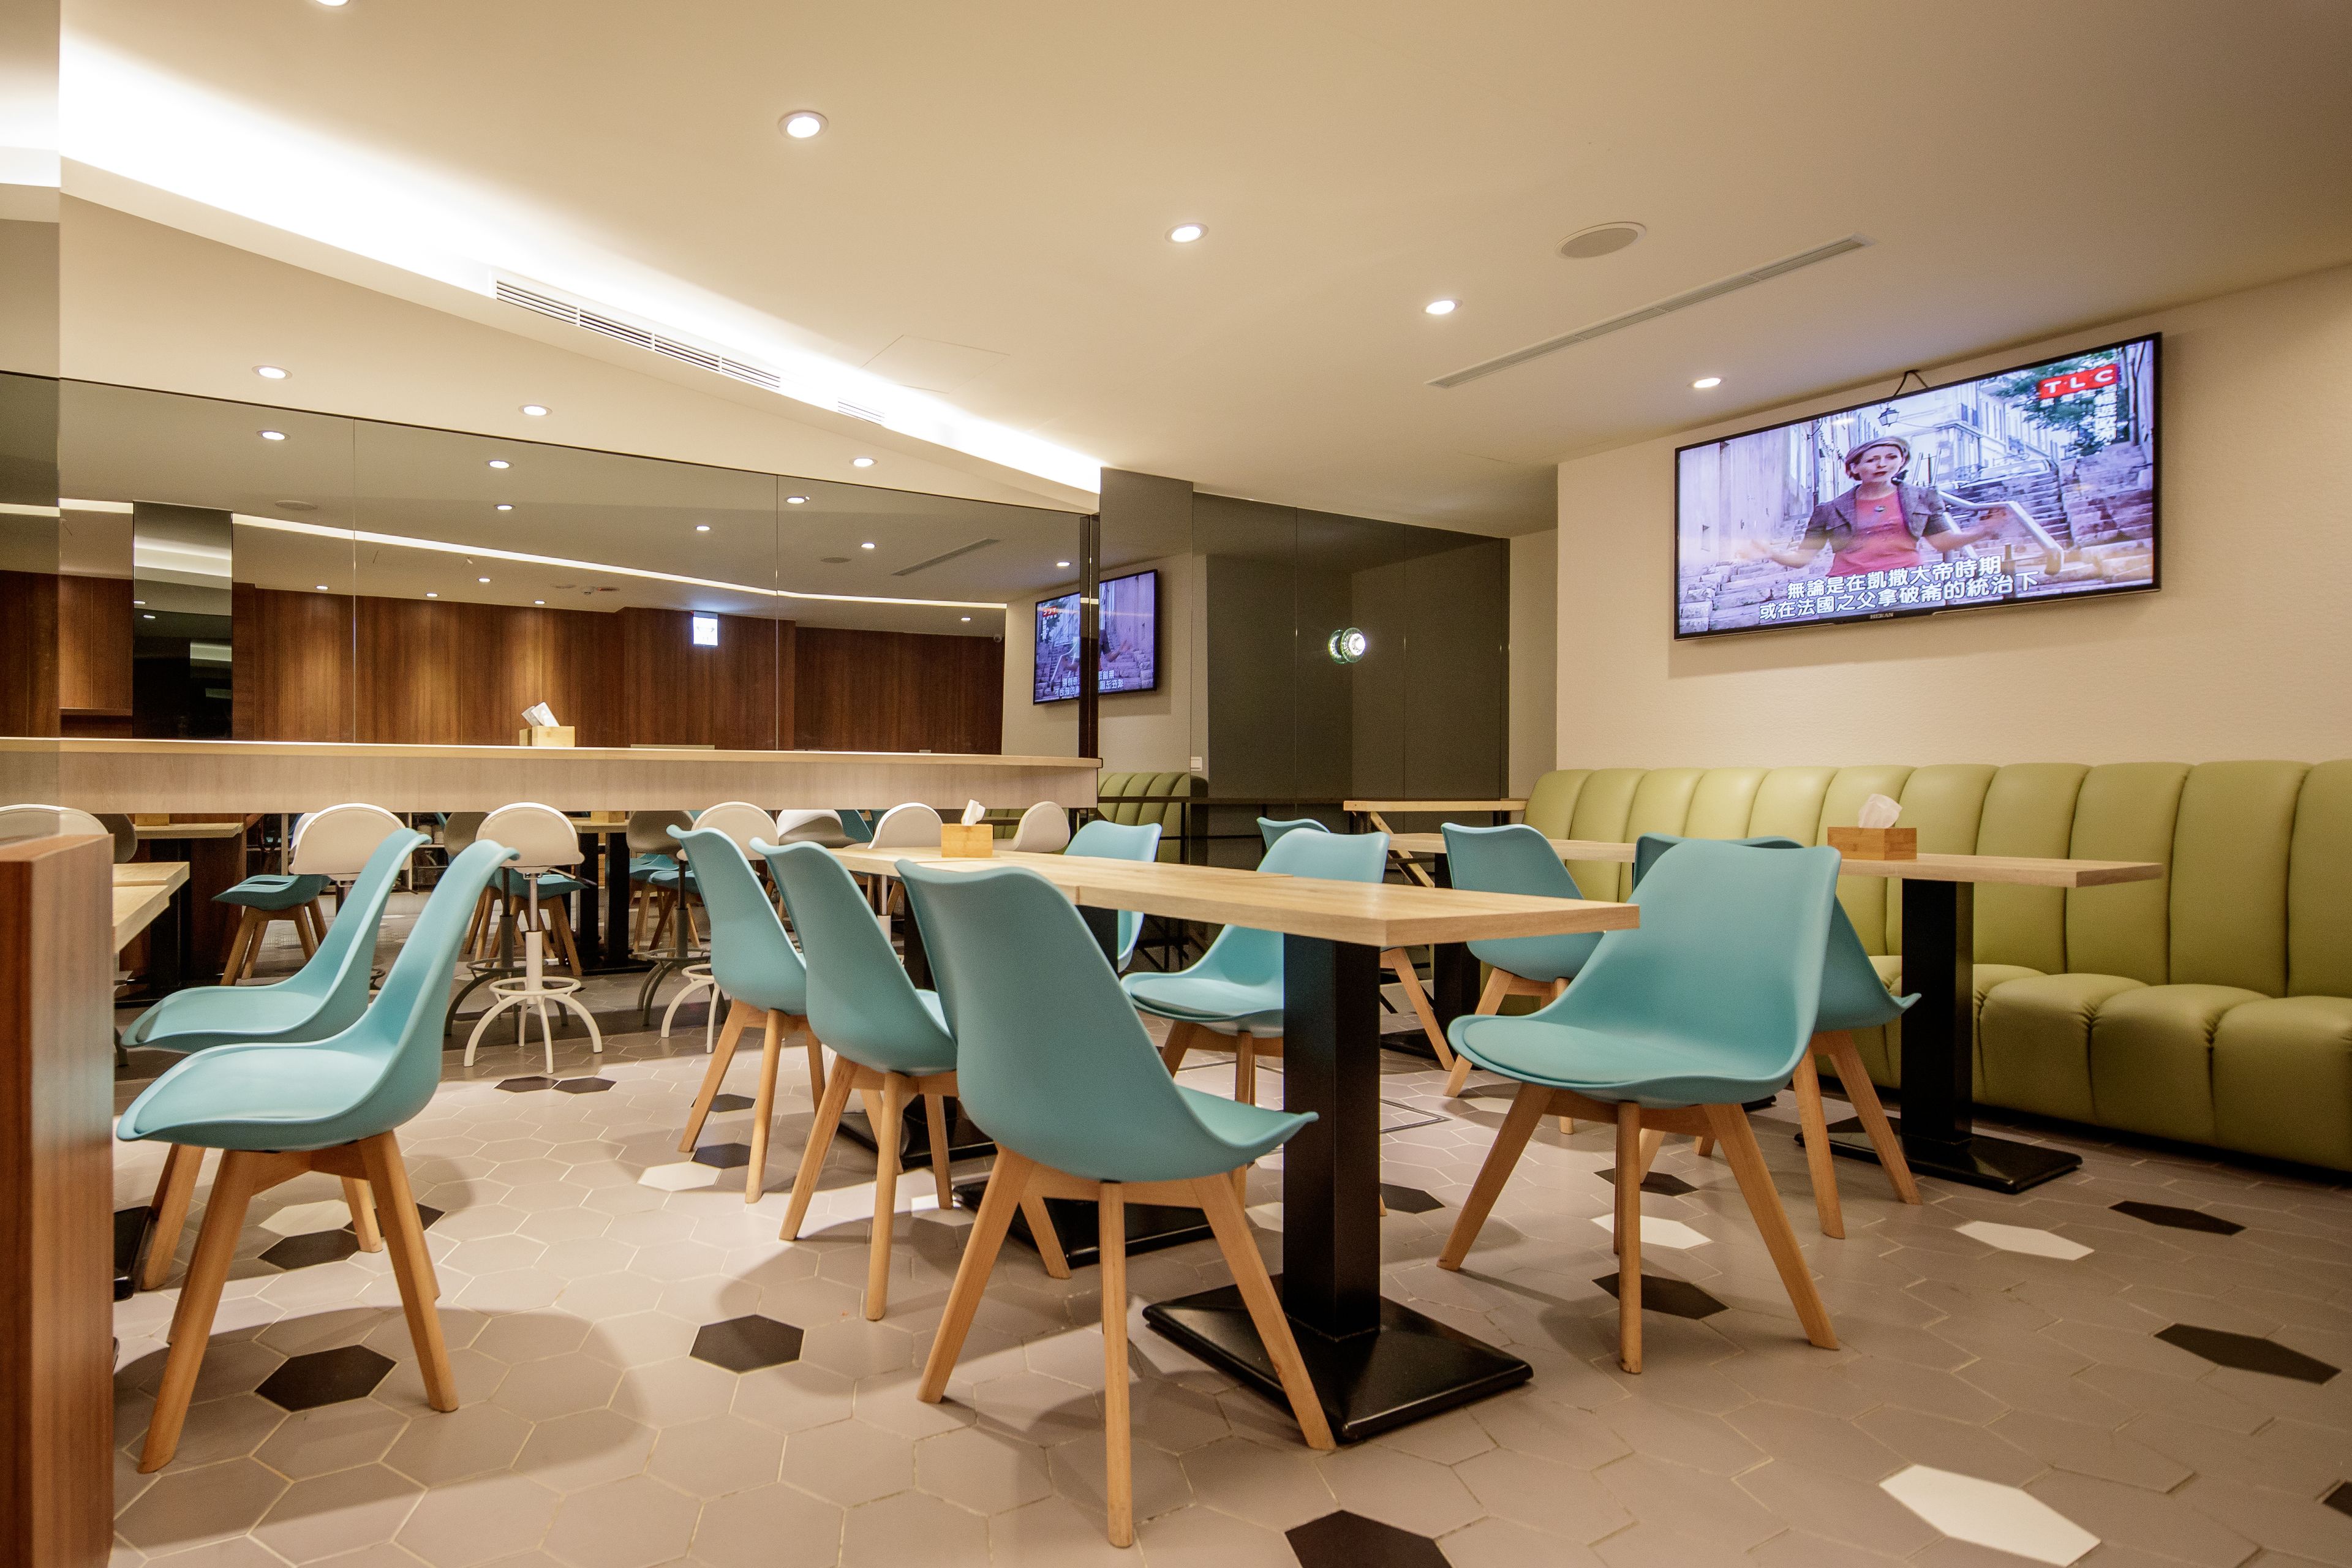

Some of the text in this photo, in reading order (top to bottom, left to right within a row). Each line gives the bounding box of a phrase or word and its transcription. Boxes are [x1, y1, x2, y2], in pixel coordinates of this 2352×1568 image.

[2044, 369, 2113, 394] TLC
[1759, 571, 2039, 620] 或在法國之父拿破崙的統治下
[1787, 555, 2001, 600] 無論是在凱撒大帝時期
